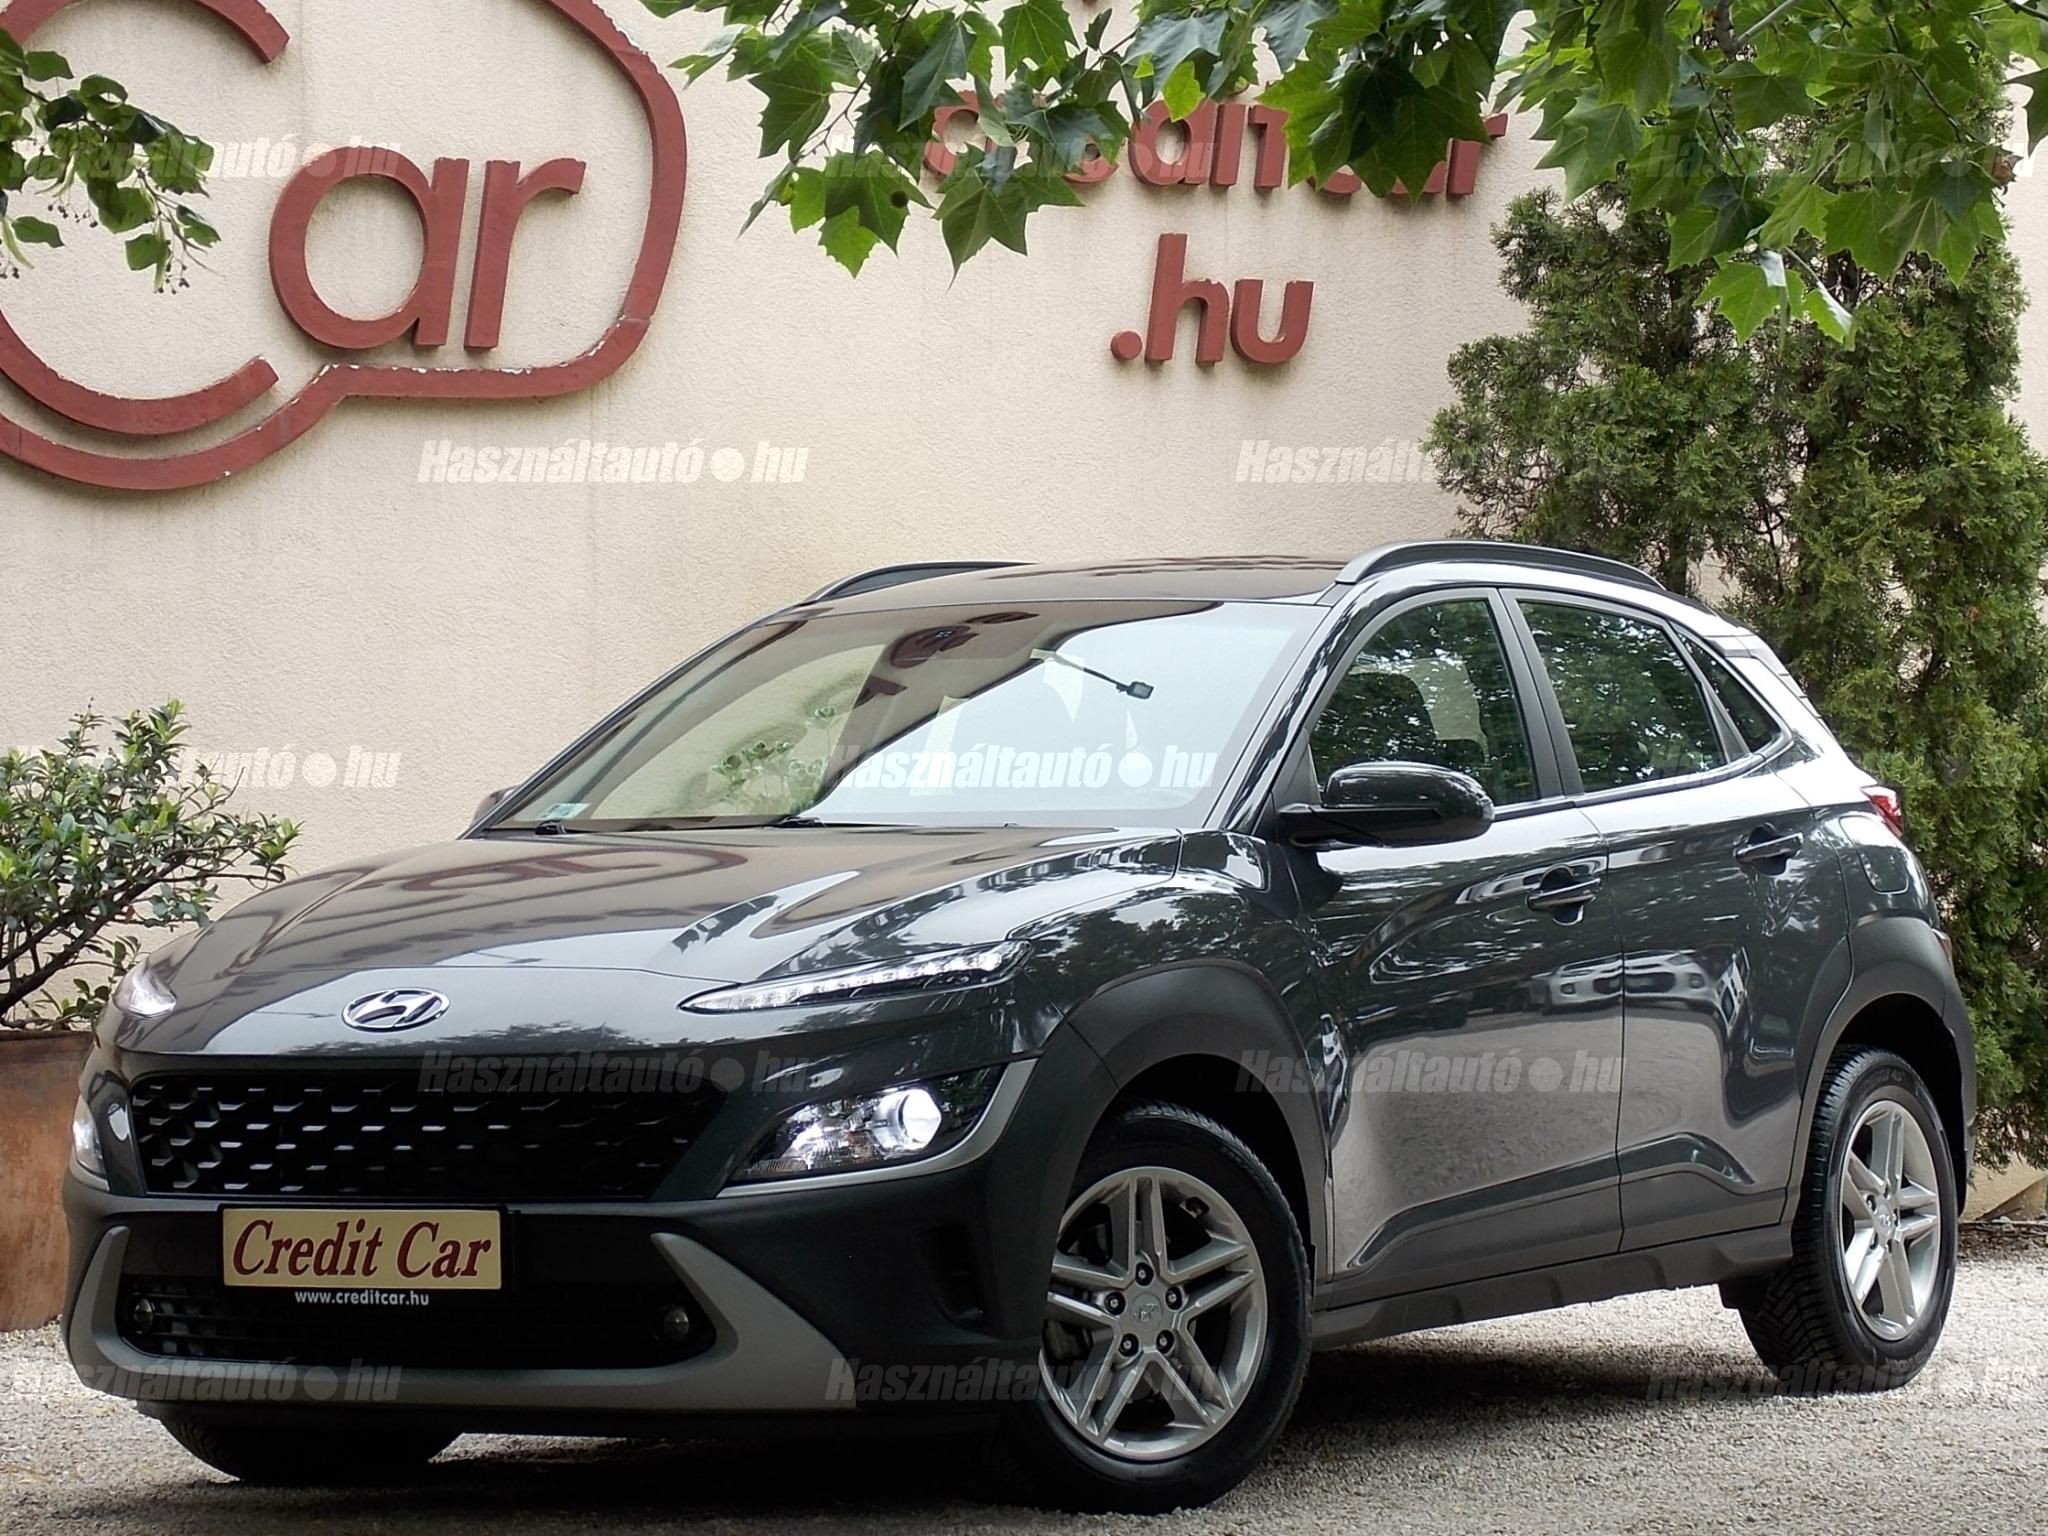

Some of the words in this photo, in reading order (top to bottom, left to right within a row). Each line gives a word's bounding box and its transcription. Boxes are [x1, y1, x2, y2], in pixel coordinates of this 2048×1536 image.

[1110, 233, 1314, 364] .hu
[232, 1218, 384, 1277] Credit
[396, 1220, 493, 1280] Car
[295, 1289, 430, 1307] www.creditcar.hu
